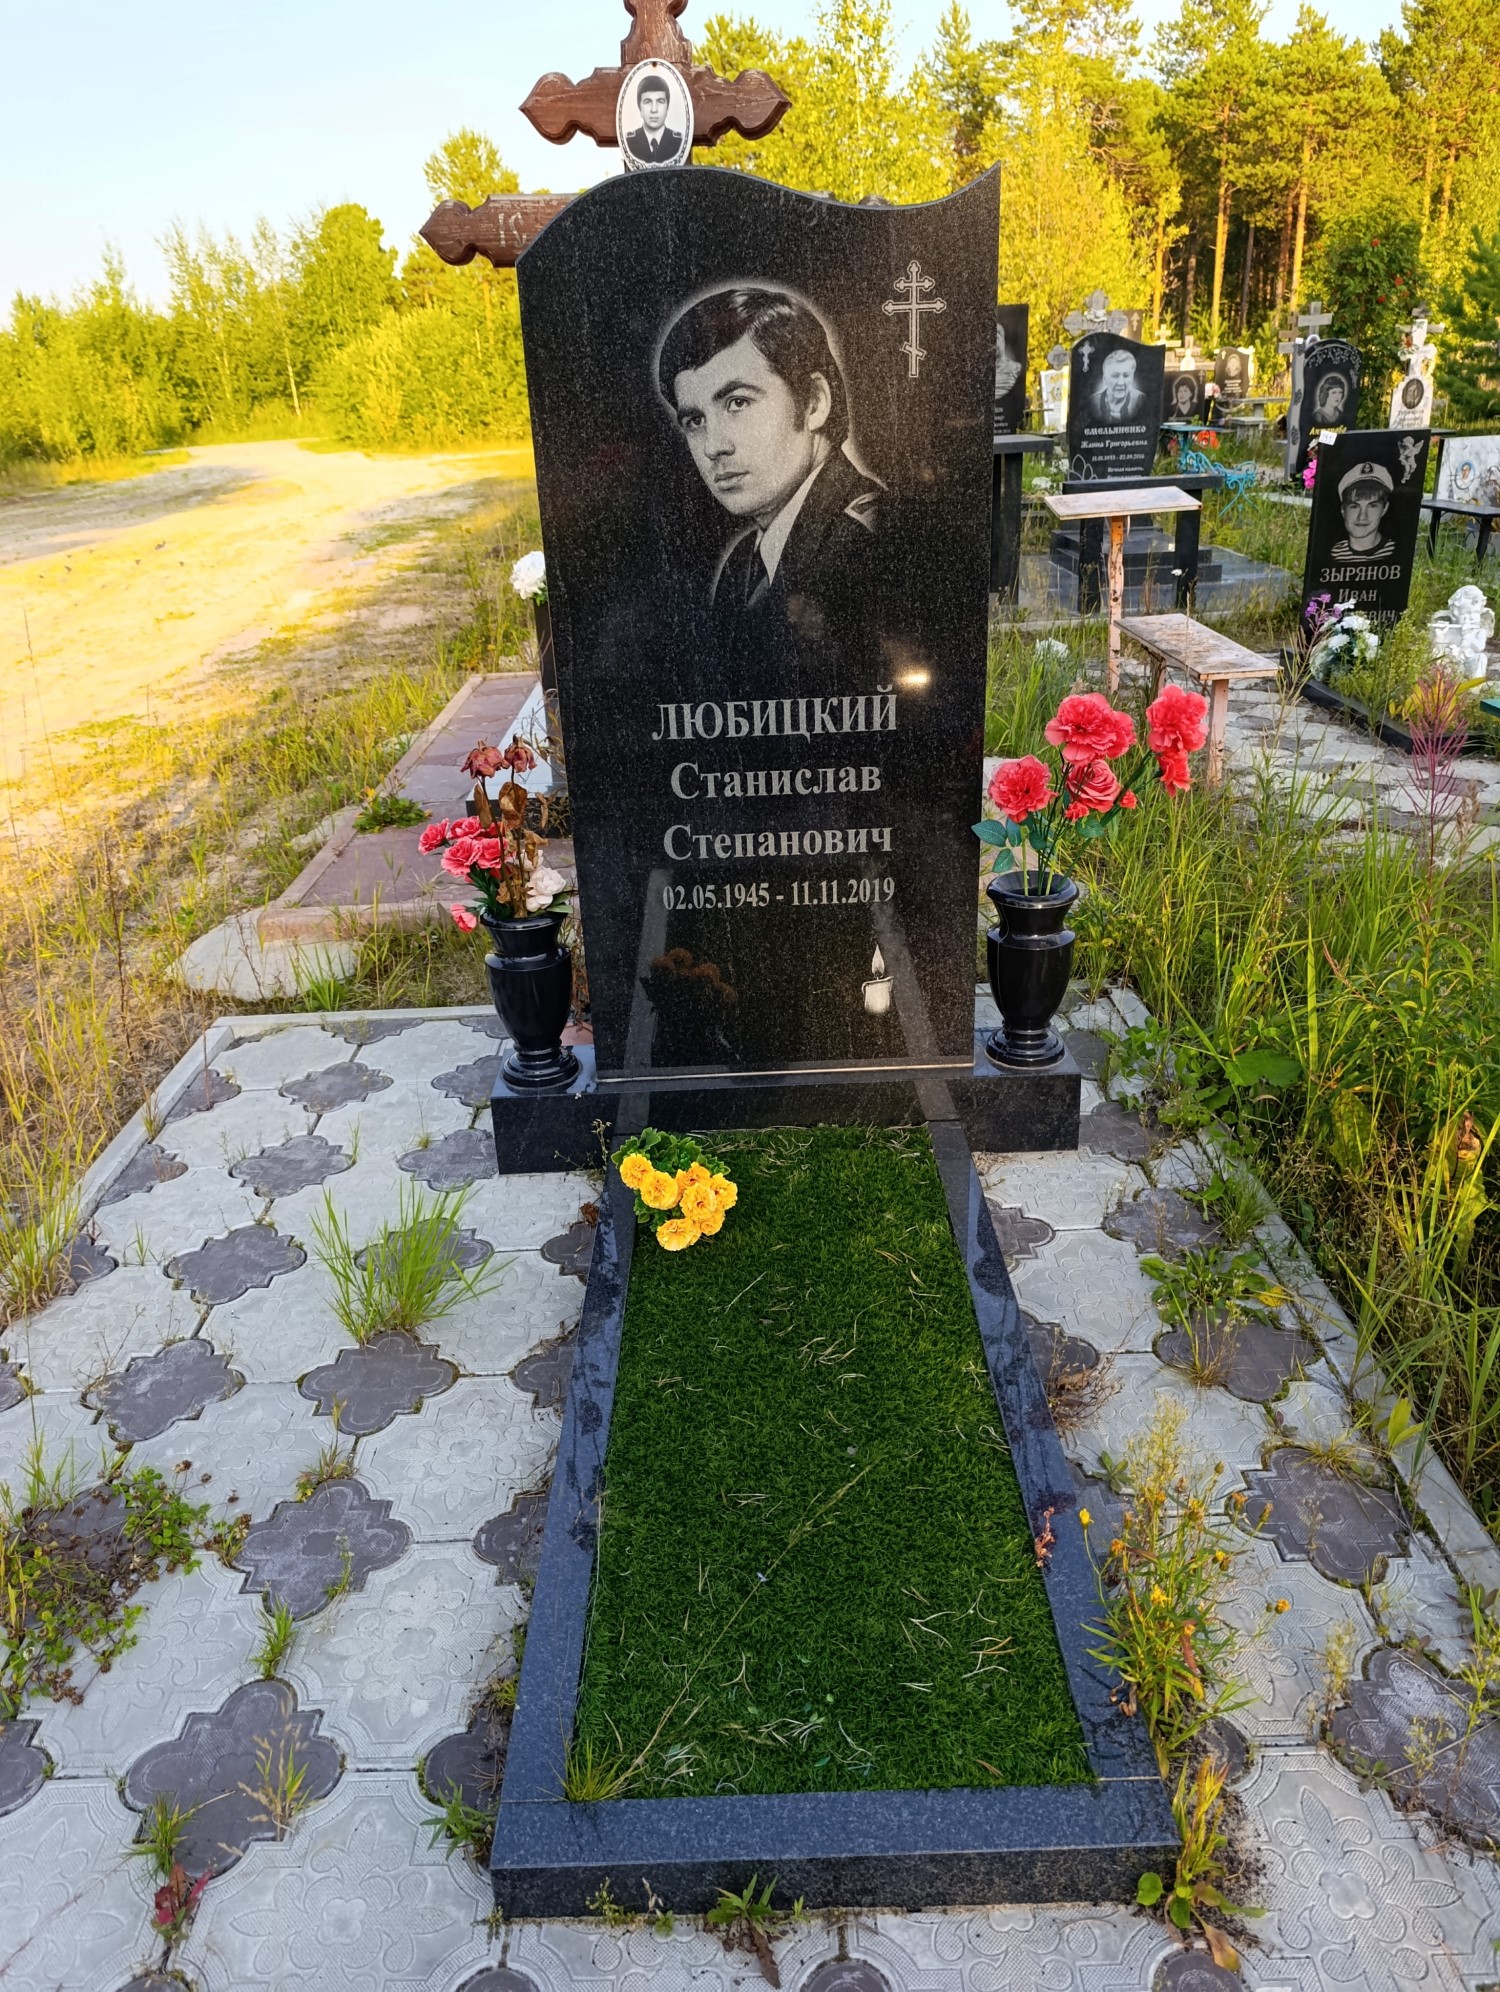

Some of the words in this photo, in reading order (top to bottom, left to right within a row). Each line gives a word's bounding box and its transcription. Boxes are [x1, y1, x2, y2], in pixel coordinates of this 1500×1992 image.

[1319, 565, 1401, 583] ЗЫРЯНОВ
[652, 684, 898, 743] ЛЮБИЦКИЙ
[670, 762, 882, 800] Станислав
[663, 824, 894, 861] Степанович
[662, 882, 770, 911] 02.05.1945
[791, 877, 895, 907] 11.11.2019
